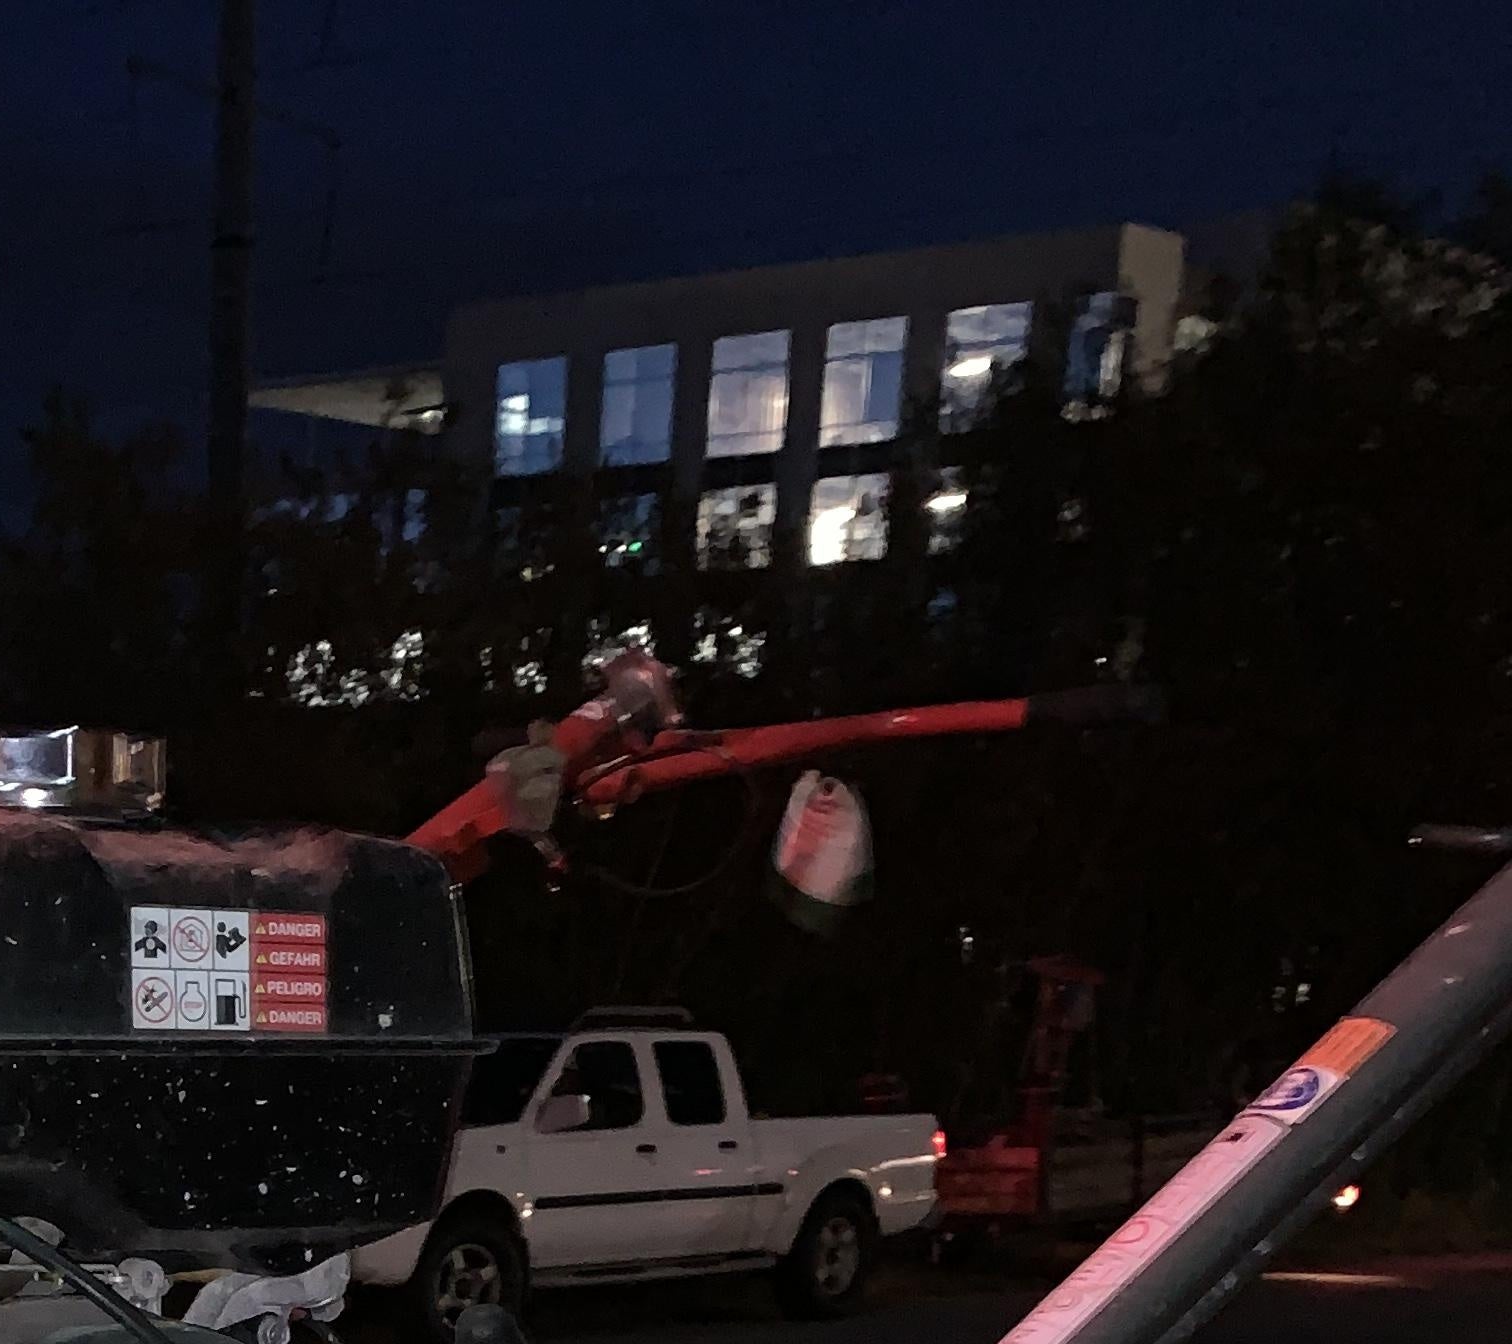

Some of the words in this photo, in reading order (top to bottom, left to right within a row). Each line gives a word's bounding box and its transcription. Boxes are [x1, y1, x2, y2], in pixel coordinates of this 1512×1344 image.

[268, 922, 321, 937] DANGER
[269, 950, 321, 966] GEFAHR
[267, 981, 322, 996] PELIGRO
[269, 1010, 322, 1025] DANGER
